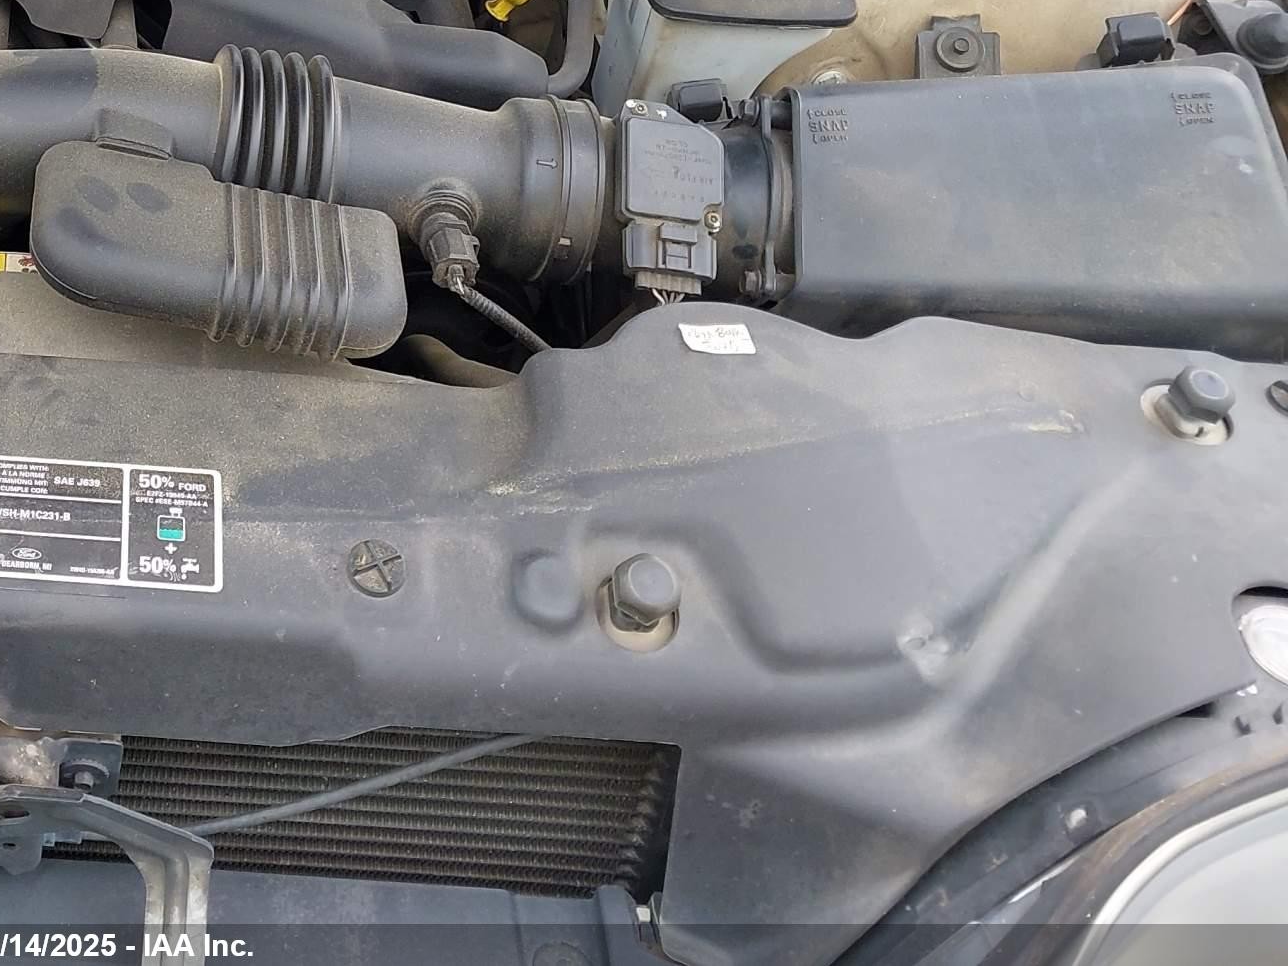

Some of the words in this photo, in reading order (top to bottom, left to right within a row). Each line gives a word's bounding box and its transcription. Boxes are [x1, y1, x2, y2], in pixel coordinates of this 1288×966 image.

[19, 470, 45, 478] NORME
[53, 476, 74, 485] SAE
[76, 478, 100, 487] J639
[138, 473, 174, 489] 50%
[178, 482, 206, 491] FORD
[0, 485, 29, 493] CUMPLE
[139, 555, 176, 574] 50%
